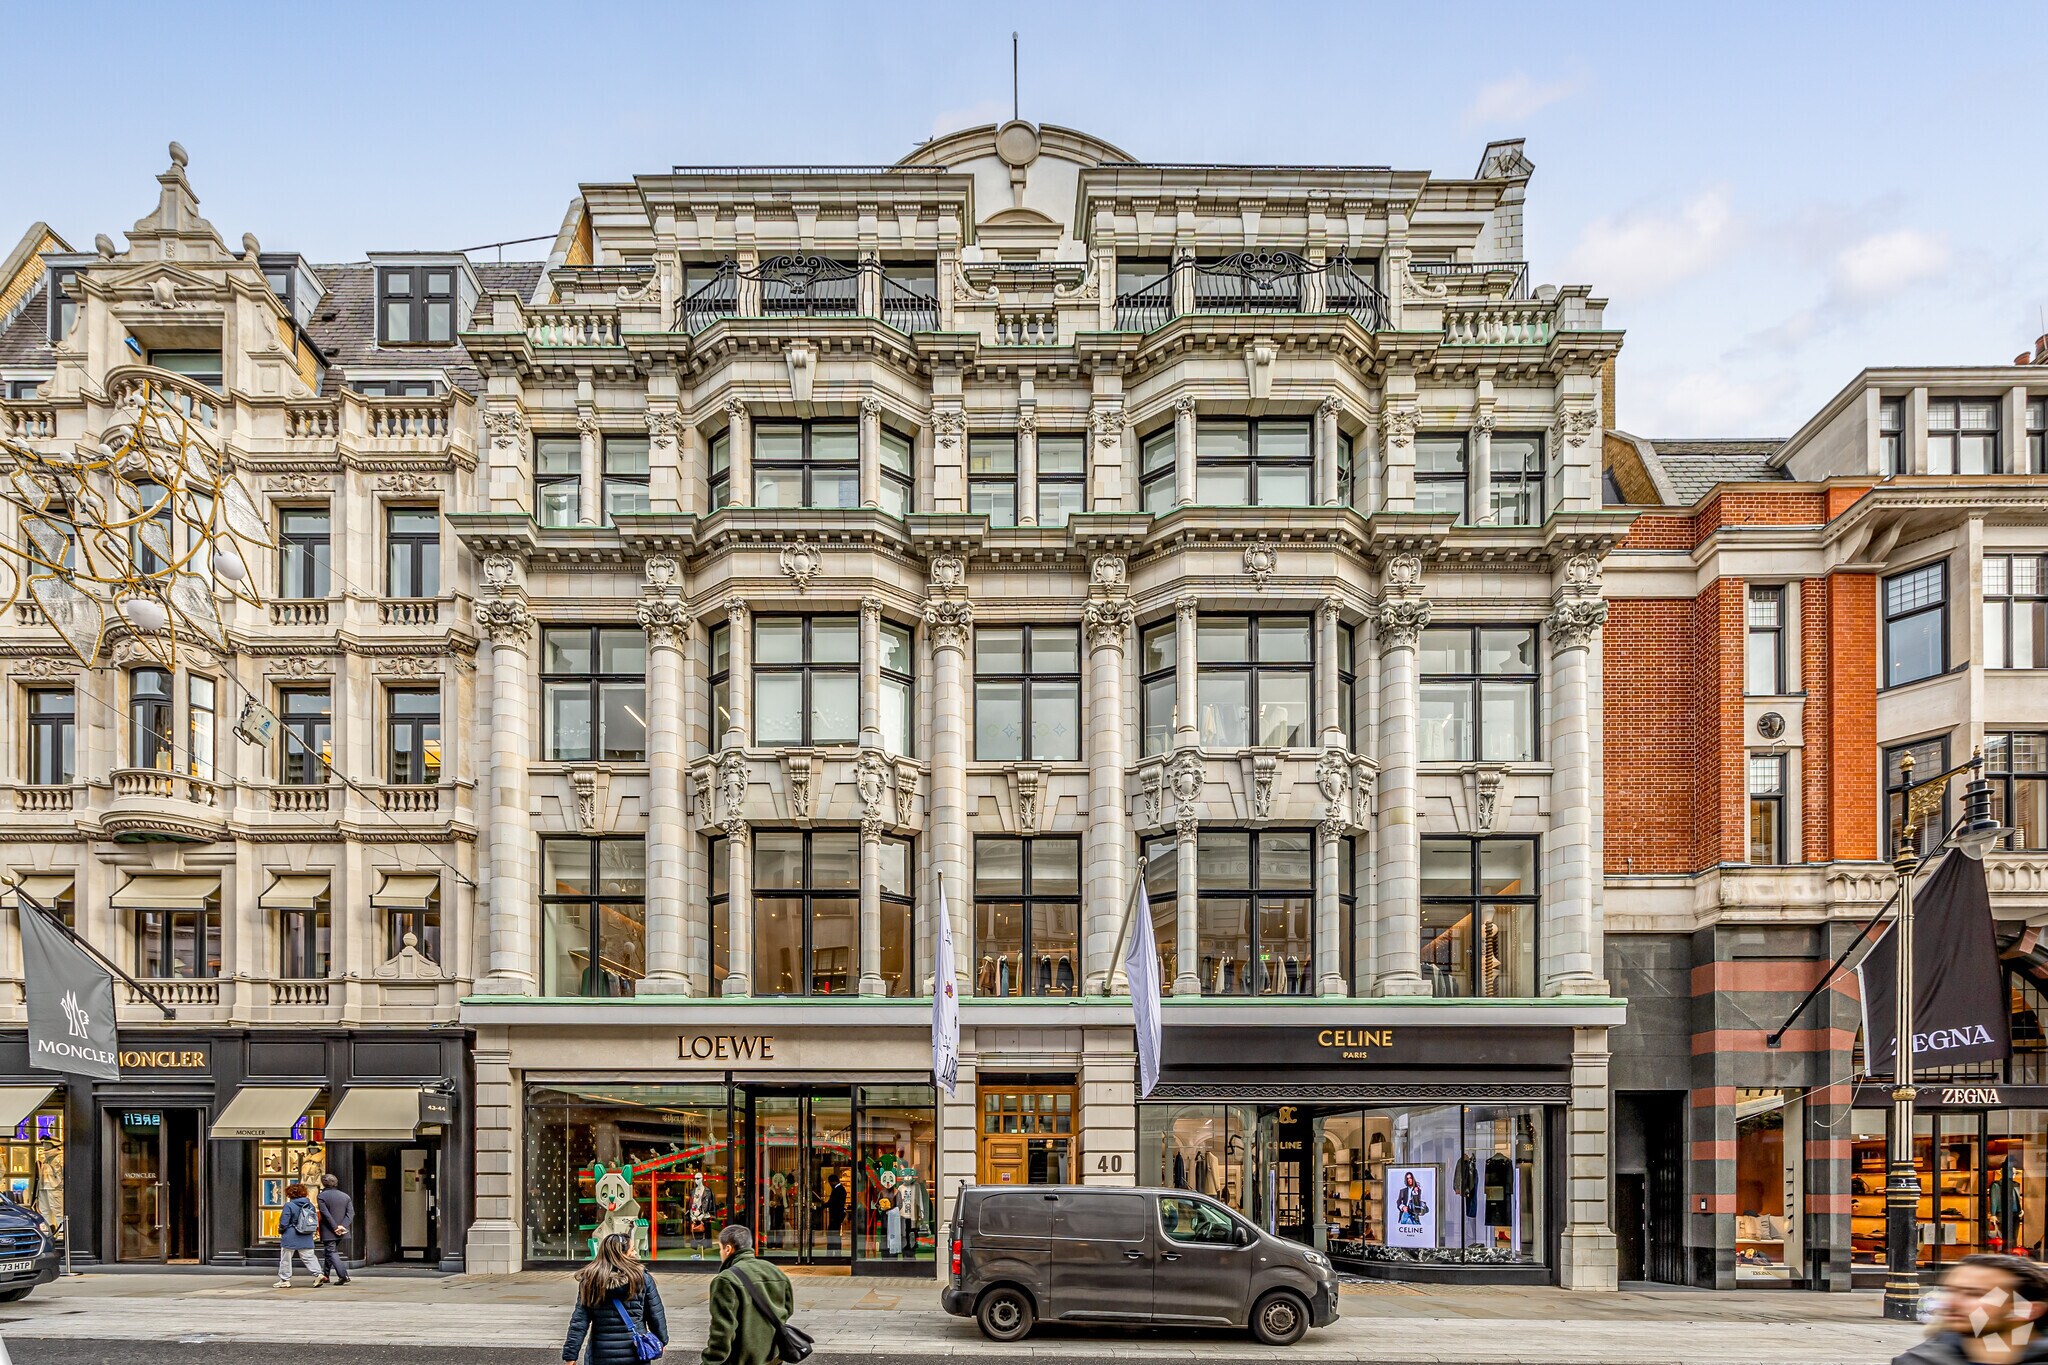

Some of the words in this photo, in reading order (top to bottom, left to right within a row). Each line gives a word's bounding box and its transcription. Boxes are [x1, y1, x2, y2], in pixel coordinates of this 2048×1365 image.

[1318, 1030, 1392, 1047] CELINE
[38, 1039, 116, 1065] MONCLER
[677, 1035, 774, 1060] LOEWE
[1942, 1088, 2001, 1104] ZEGNA
[1097, 1155, 1122, 1172] 40
[14, 1262, 30, 1270] HTP
